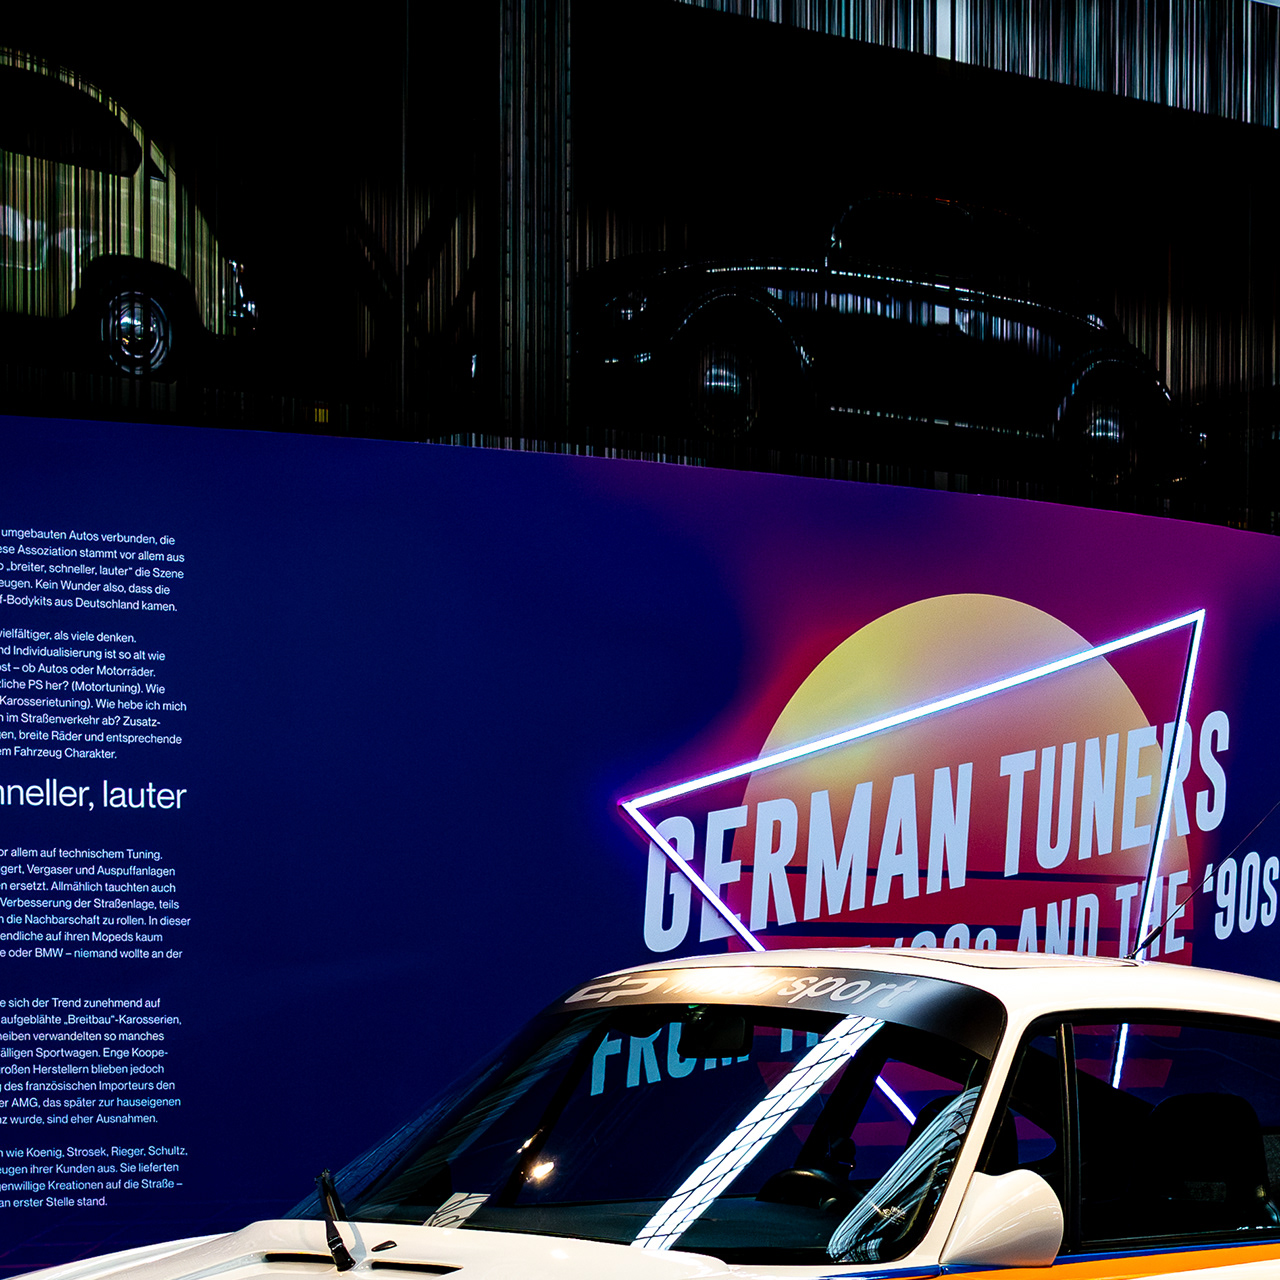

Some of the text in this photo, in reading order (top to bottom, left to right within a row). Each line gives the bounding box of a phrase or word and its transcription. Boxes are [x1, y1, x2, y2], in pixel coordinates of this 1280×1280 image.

[104, 780, 187, 809] lauter
[644, 762, 973, 952] GERMAN
[1000, 711, 1230, 877] TUNERS
[1116, 870, 1189, 959] THE
[663, 966, 918, 1008] moorsport
[5, 1147, 24, 1158] wie
[26, 1147, 65, 1160] Koenig,
[66, 1146, 109, 1158] Strosek,
[111, 1145, 147, 1159] Rieger,
[147, 1145, 188, 1156] Schultz,
[29, 1164, 54, 1175] ihrer
[55, 1163, 96, 1174] Kunden
[96, 1164, 118, 1174] aus.
[119, 1162, 137, 1173] Sie
[138, 1162, 180, 1173] lieferten
[47, 1180, 104, 1191] Kreationen
[105, 1178, 122, 1190] auf
[123, 1178, 140, 1190] die
[141, 1178, 175, 1189] Straße
[12, 1197, 44, 1208] erster
[45, 1196, 75, 1207] Stelle
[76, 1196, 108, 1207] stand.
